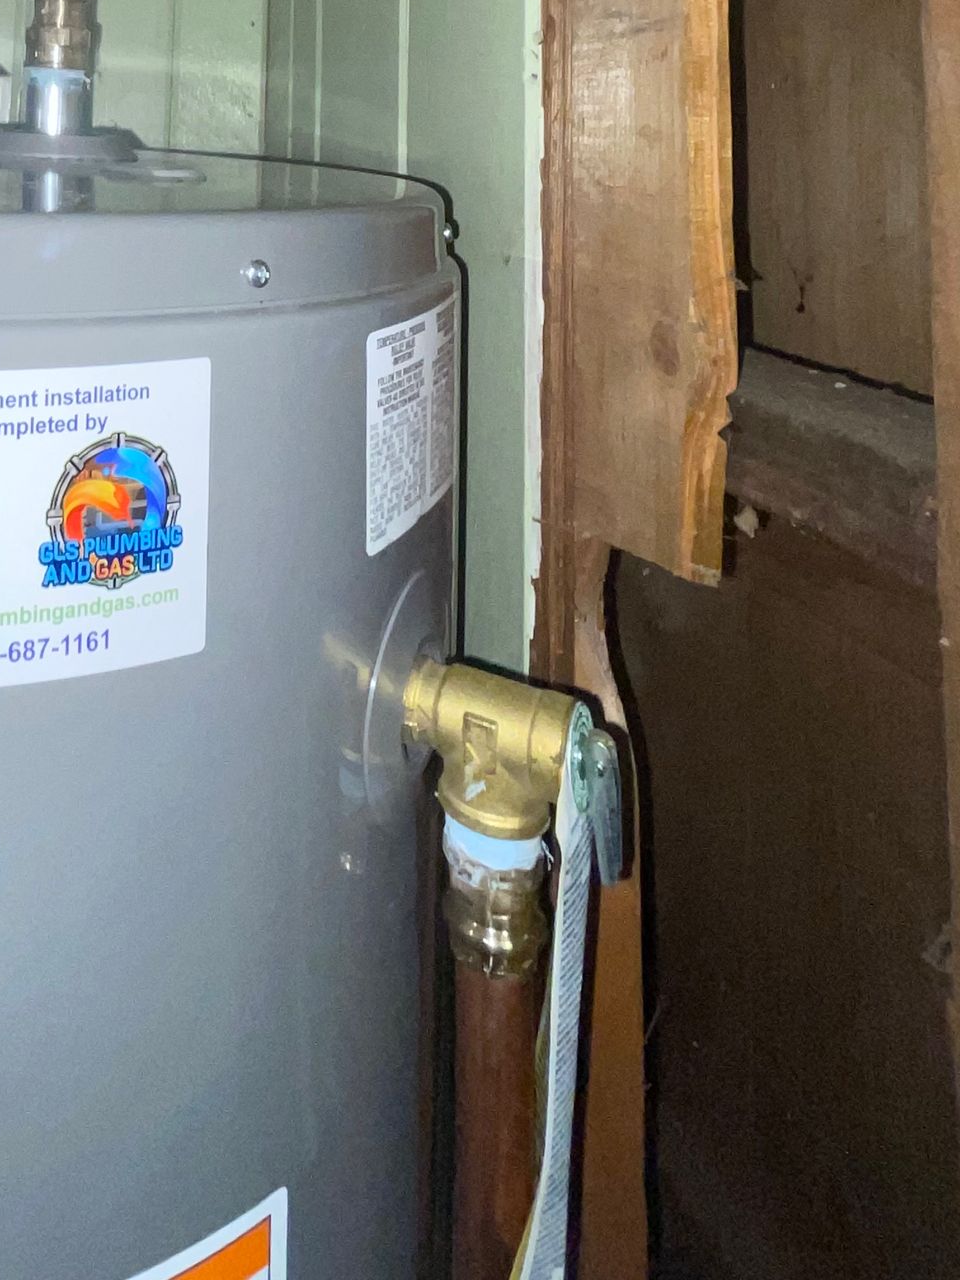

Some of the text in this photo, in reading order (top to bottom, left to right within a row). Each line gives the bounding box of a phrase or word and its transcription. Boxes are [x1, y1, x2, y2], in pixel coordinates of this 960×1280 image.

[44, 384, 150, 407] installation
[85, 413, 108, 434] by
[39, 525, 184, 565] GLS PLUMBING
[42, 548, 174, 587] AND GAS LTD
